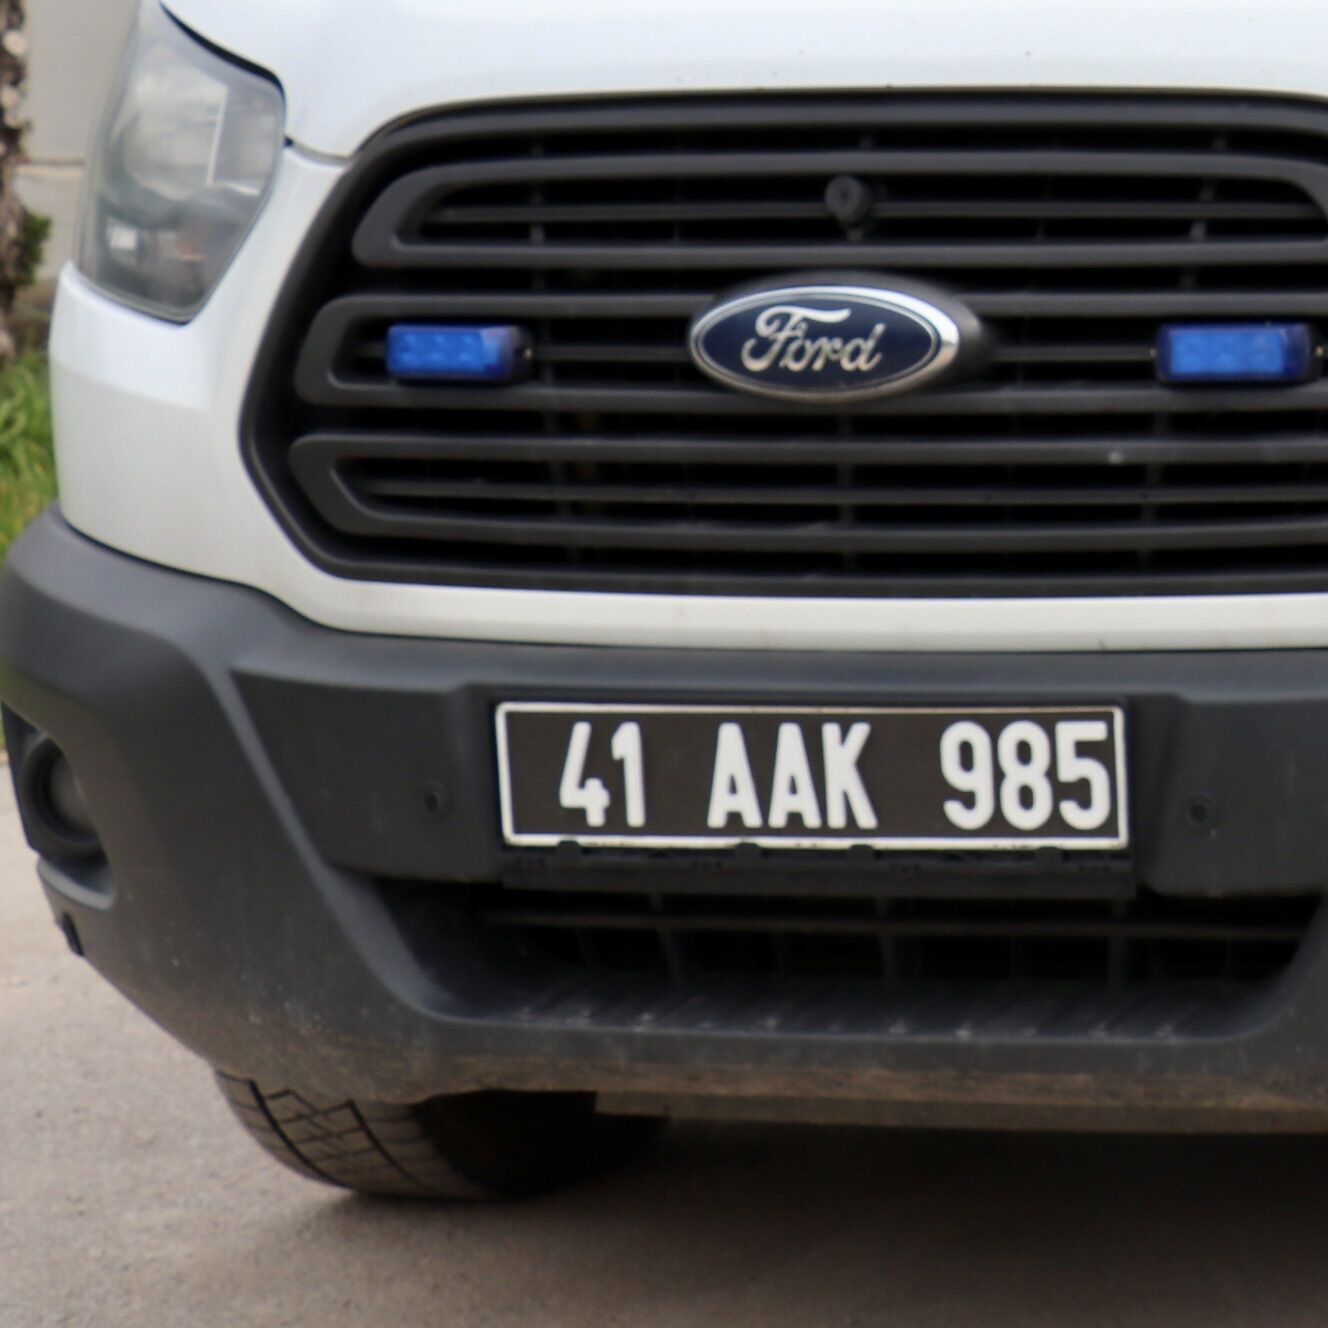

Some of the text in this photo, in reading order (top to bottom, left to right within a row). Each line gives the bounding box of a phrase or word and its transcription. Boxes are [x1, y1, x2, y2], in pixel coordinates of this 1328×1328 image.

[741, 305, 886, 372] Ford
[559, 720, 1111, 830] 41 AAK 985
